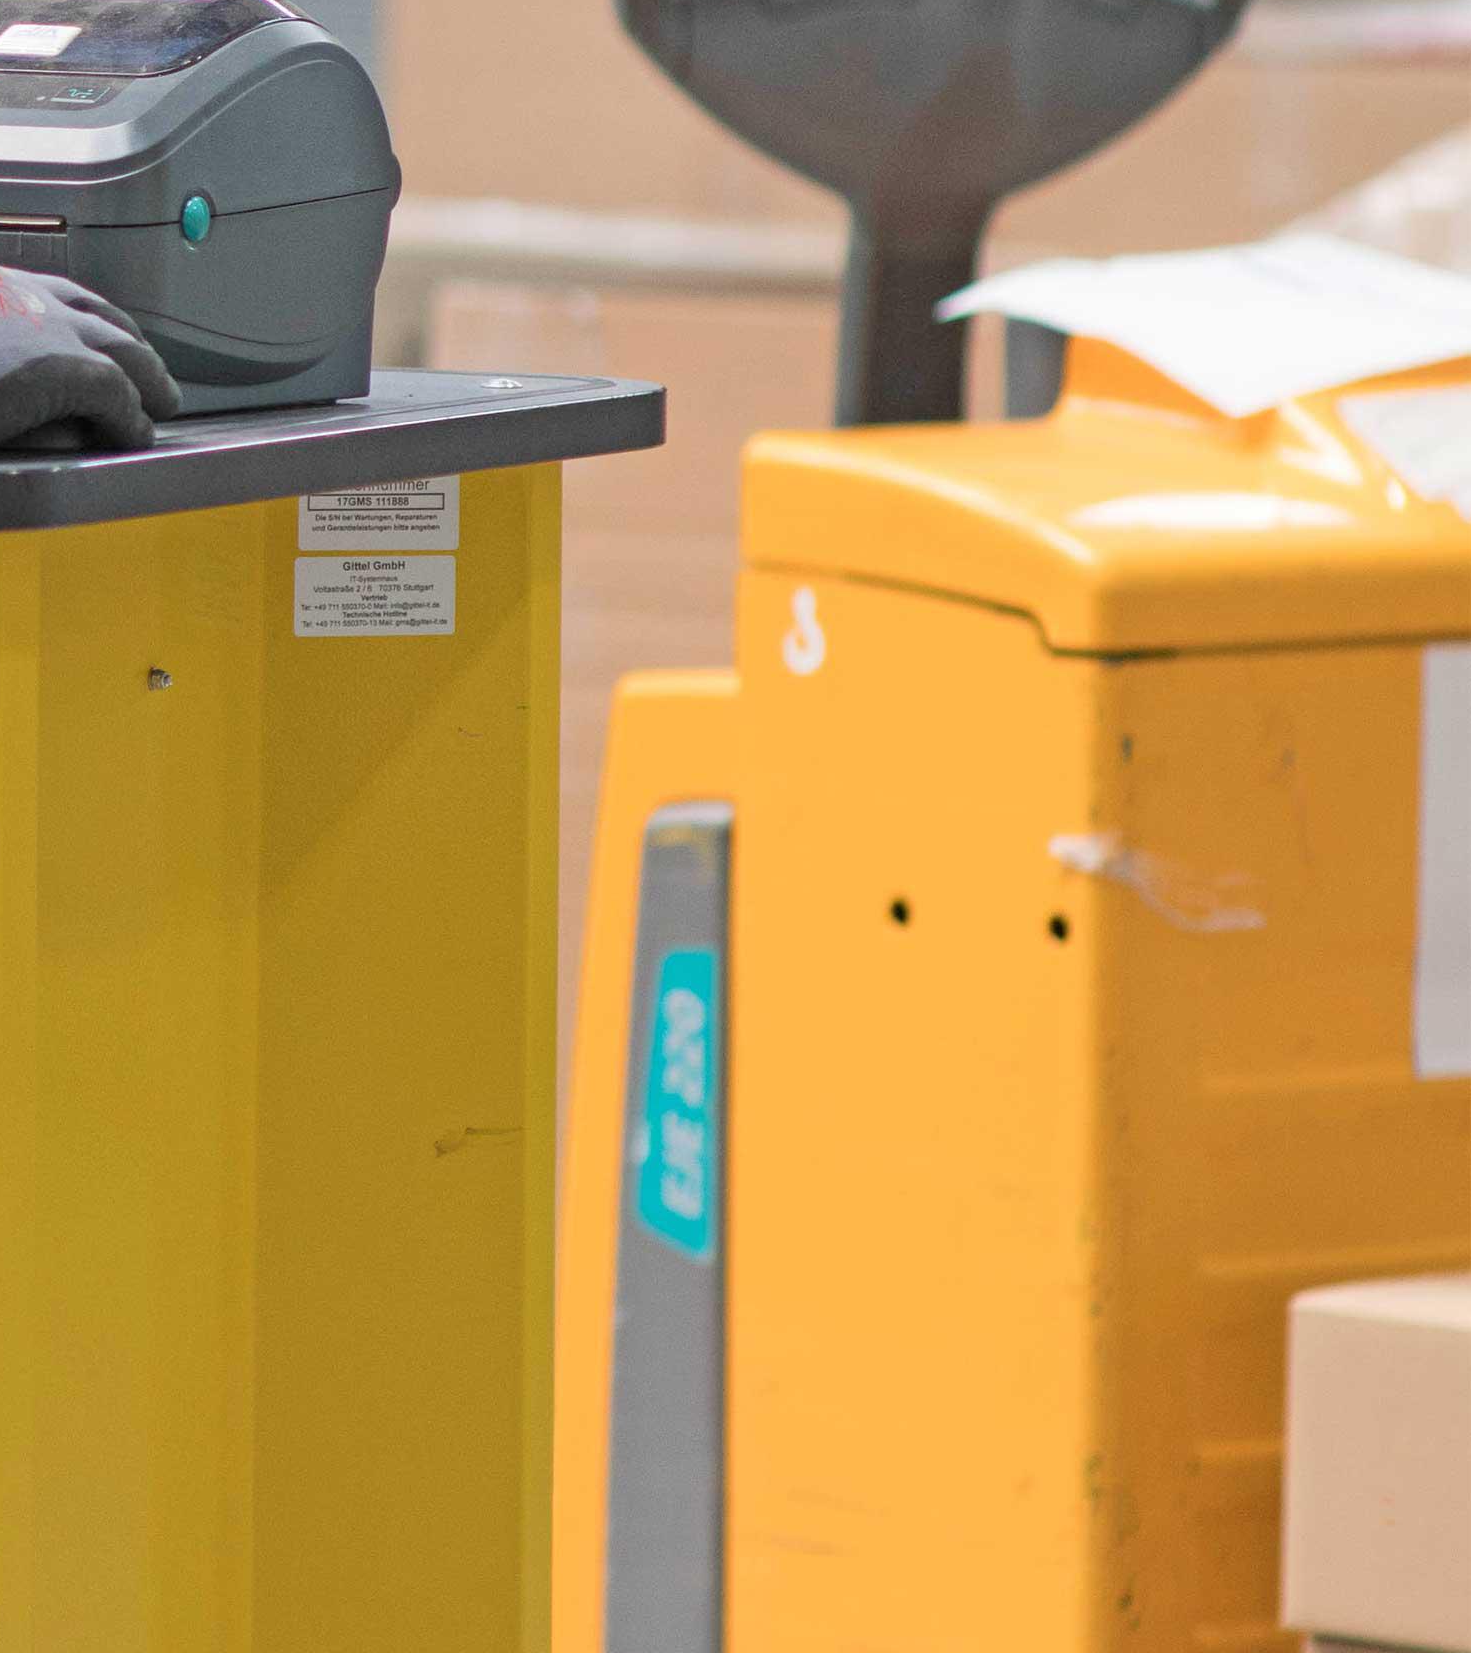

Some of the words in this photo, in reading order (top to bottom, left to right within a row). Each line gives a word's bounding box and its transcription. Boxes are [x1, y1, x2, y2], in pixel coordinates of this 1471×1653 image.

[337, 497, 373, 507] 17GMS
[395, 513, 438, 521] Reparaturen
[343, 561, 370, 571] Gittel
[373, 561, 405, 570] GmbH
[361, 594, 388, 602] Vertrieb
